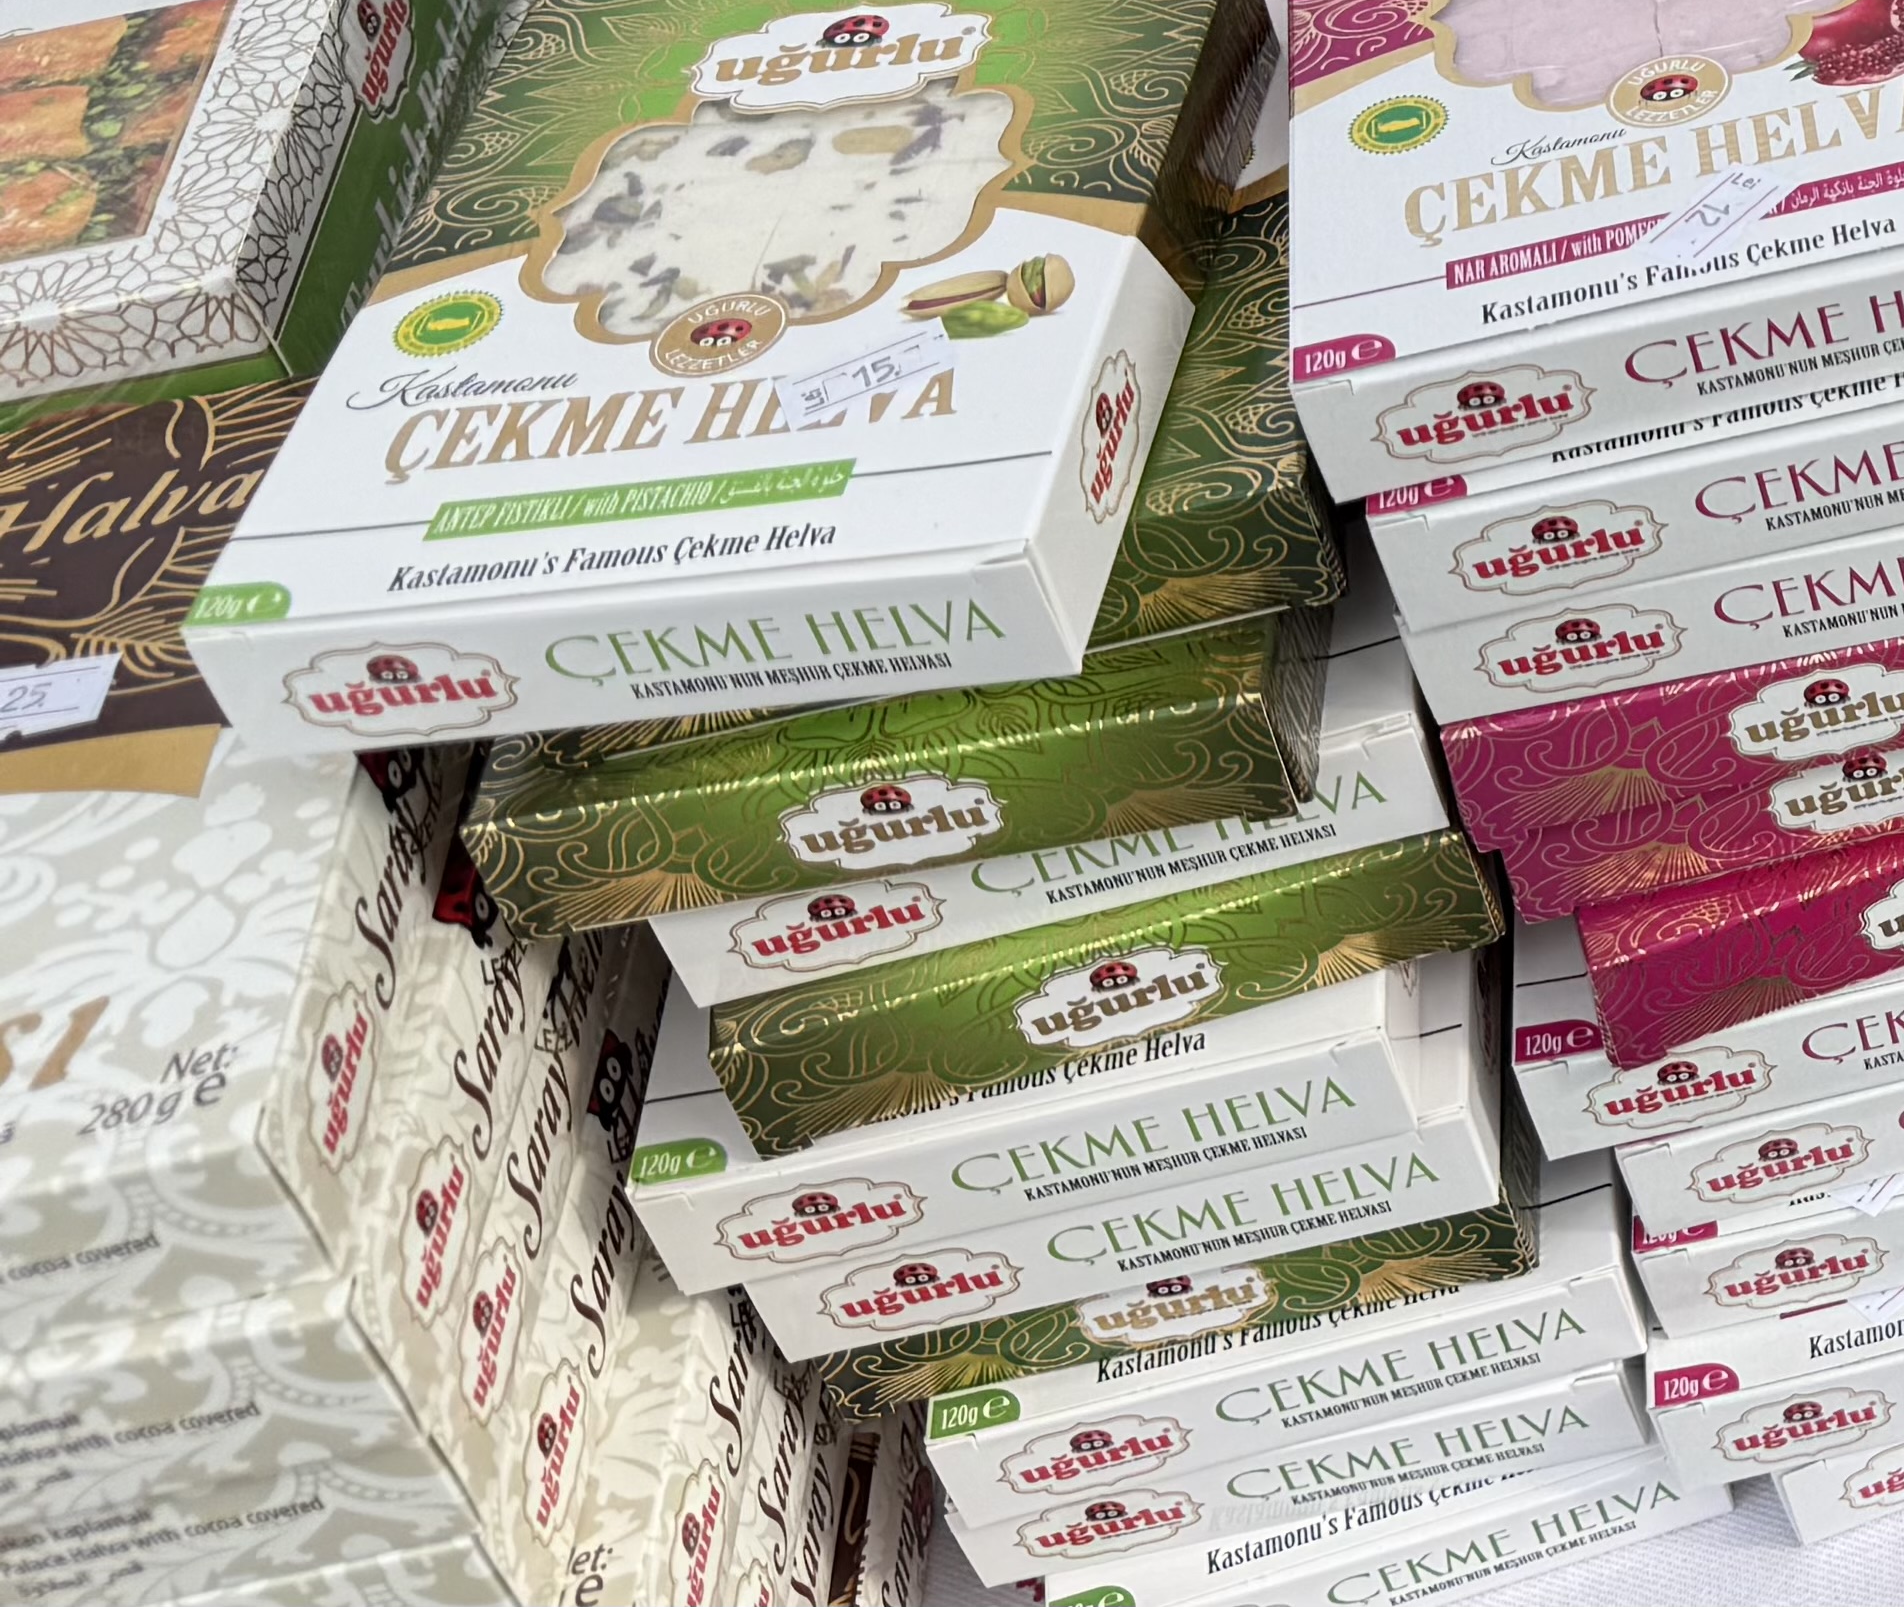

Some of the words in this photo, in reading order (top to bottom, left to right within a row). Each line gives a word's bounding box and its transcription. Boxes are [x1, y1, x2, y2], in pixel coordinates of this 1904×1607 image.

[1630, 57, 1706, 88] UĞURLU
[1491, 127, 1628, 167] Kastamonu
[1404, 135, 1673, 248] ÇEKME
[1453, 257, 1496, 283] NAR
[1498, 241, 1559, 279] AROMALI
[1570, 230, 1604, 258] with
[1481, 271, 1640, 326] Kastamonu's
[1746, 231, 1826, 269] Çekme
[1831, 216, 1897, 248] Helva
[1303, 346, 1347, 376] 120g
[1623, 299, 1849, 388] ÇEKME
[1696, 351, 1817, 397] KASTAMONU'NUN
[1820, 340, 1879, 370] MEŞHUR
[345, 366, 581, 412] Kastamonu
[1396, 386, 1573, 447] uğurlu
[383, 387, 683, 484] ÇEKME
[0, 468, 266, 554] Halva
[435, 502, 498, 535] ANTEP
[624, 478, 711, 513] PISTACHIO
[1765, 492, 1884, 532] KASTAMONU'NUN
[386, 547, 560, 593] Kastamonu's
[563, 540, 668, 574] Famous
[673, 528, 761, 564] Çekme
[764, 521, 837, 551] Helva
[1472, 520, 1645, 580] uğurlu
[545, 616, 792, 686] ÇEKME
[804, 597, 1006, 654] HELVA
[1496, 625, 1665, 679] uğurlu
[630, 669, 763, 700] KASTAMONU'NUN
[833, 656, 887, 683] ÇEKME
[888, 651, 952, 676] HELVASI
[159, 1041, 241, 1084] Net:
[454, 960, 530, 1163] Saray
[1524, 1031, 1563, 1058] 120g
[1605, 1064, 1758, 1116] uğurlu
[507, 1053, 576, 1262] Saray
[952, 1115, 1169, 1195] ÇEKME
[1182, 1075, 1357, 1142] HELVA
[639, 1151, 683, 1180] 120g
[1707, 1140, 1857, 1195] uğurlu
[1725, 1245, 1871, 1299] uğurlu
[1215, 1347, 1413, 1426] ÇEKME
[1431, 1306, 1588, 1367] HELVA
[1663, 1374, 1701, 1401] 120g
[939, 1401, 981, 1430] 120g
[1733, 1398, 1878, 1453] uğurlu
